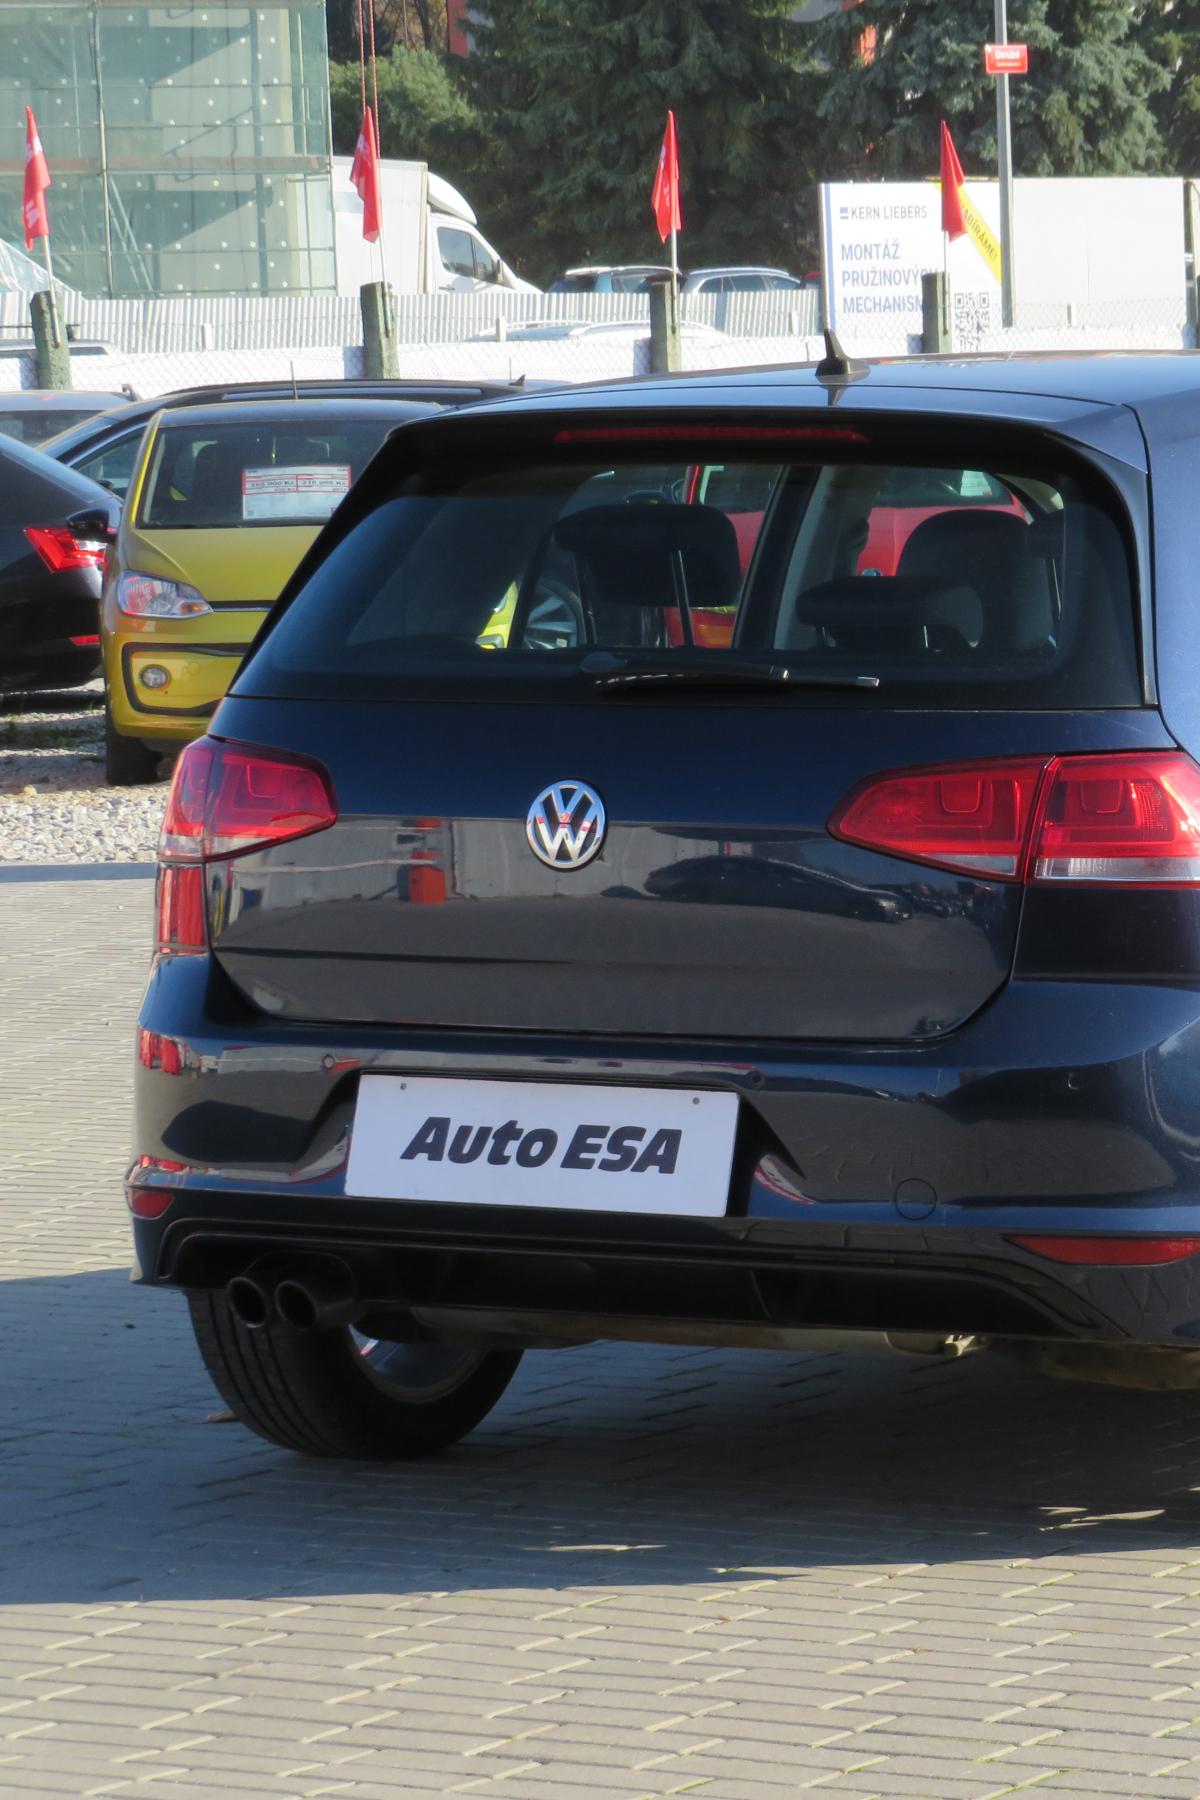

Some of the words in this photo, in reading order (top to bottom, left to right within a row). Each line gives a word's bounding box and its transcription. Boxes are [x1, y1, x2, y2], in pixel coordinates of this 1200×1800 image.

[851, 205, 880, 220] KERN
[884, 205, 927, 219] LIEBERS
[841, 238, 901, 261] MONTÁŽ
[842, 264, 938, 288] PRUŽINOVÝ
[400, 1116, 558, 1169] Auto
[560, 1124, 683, 1175] ESA
